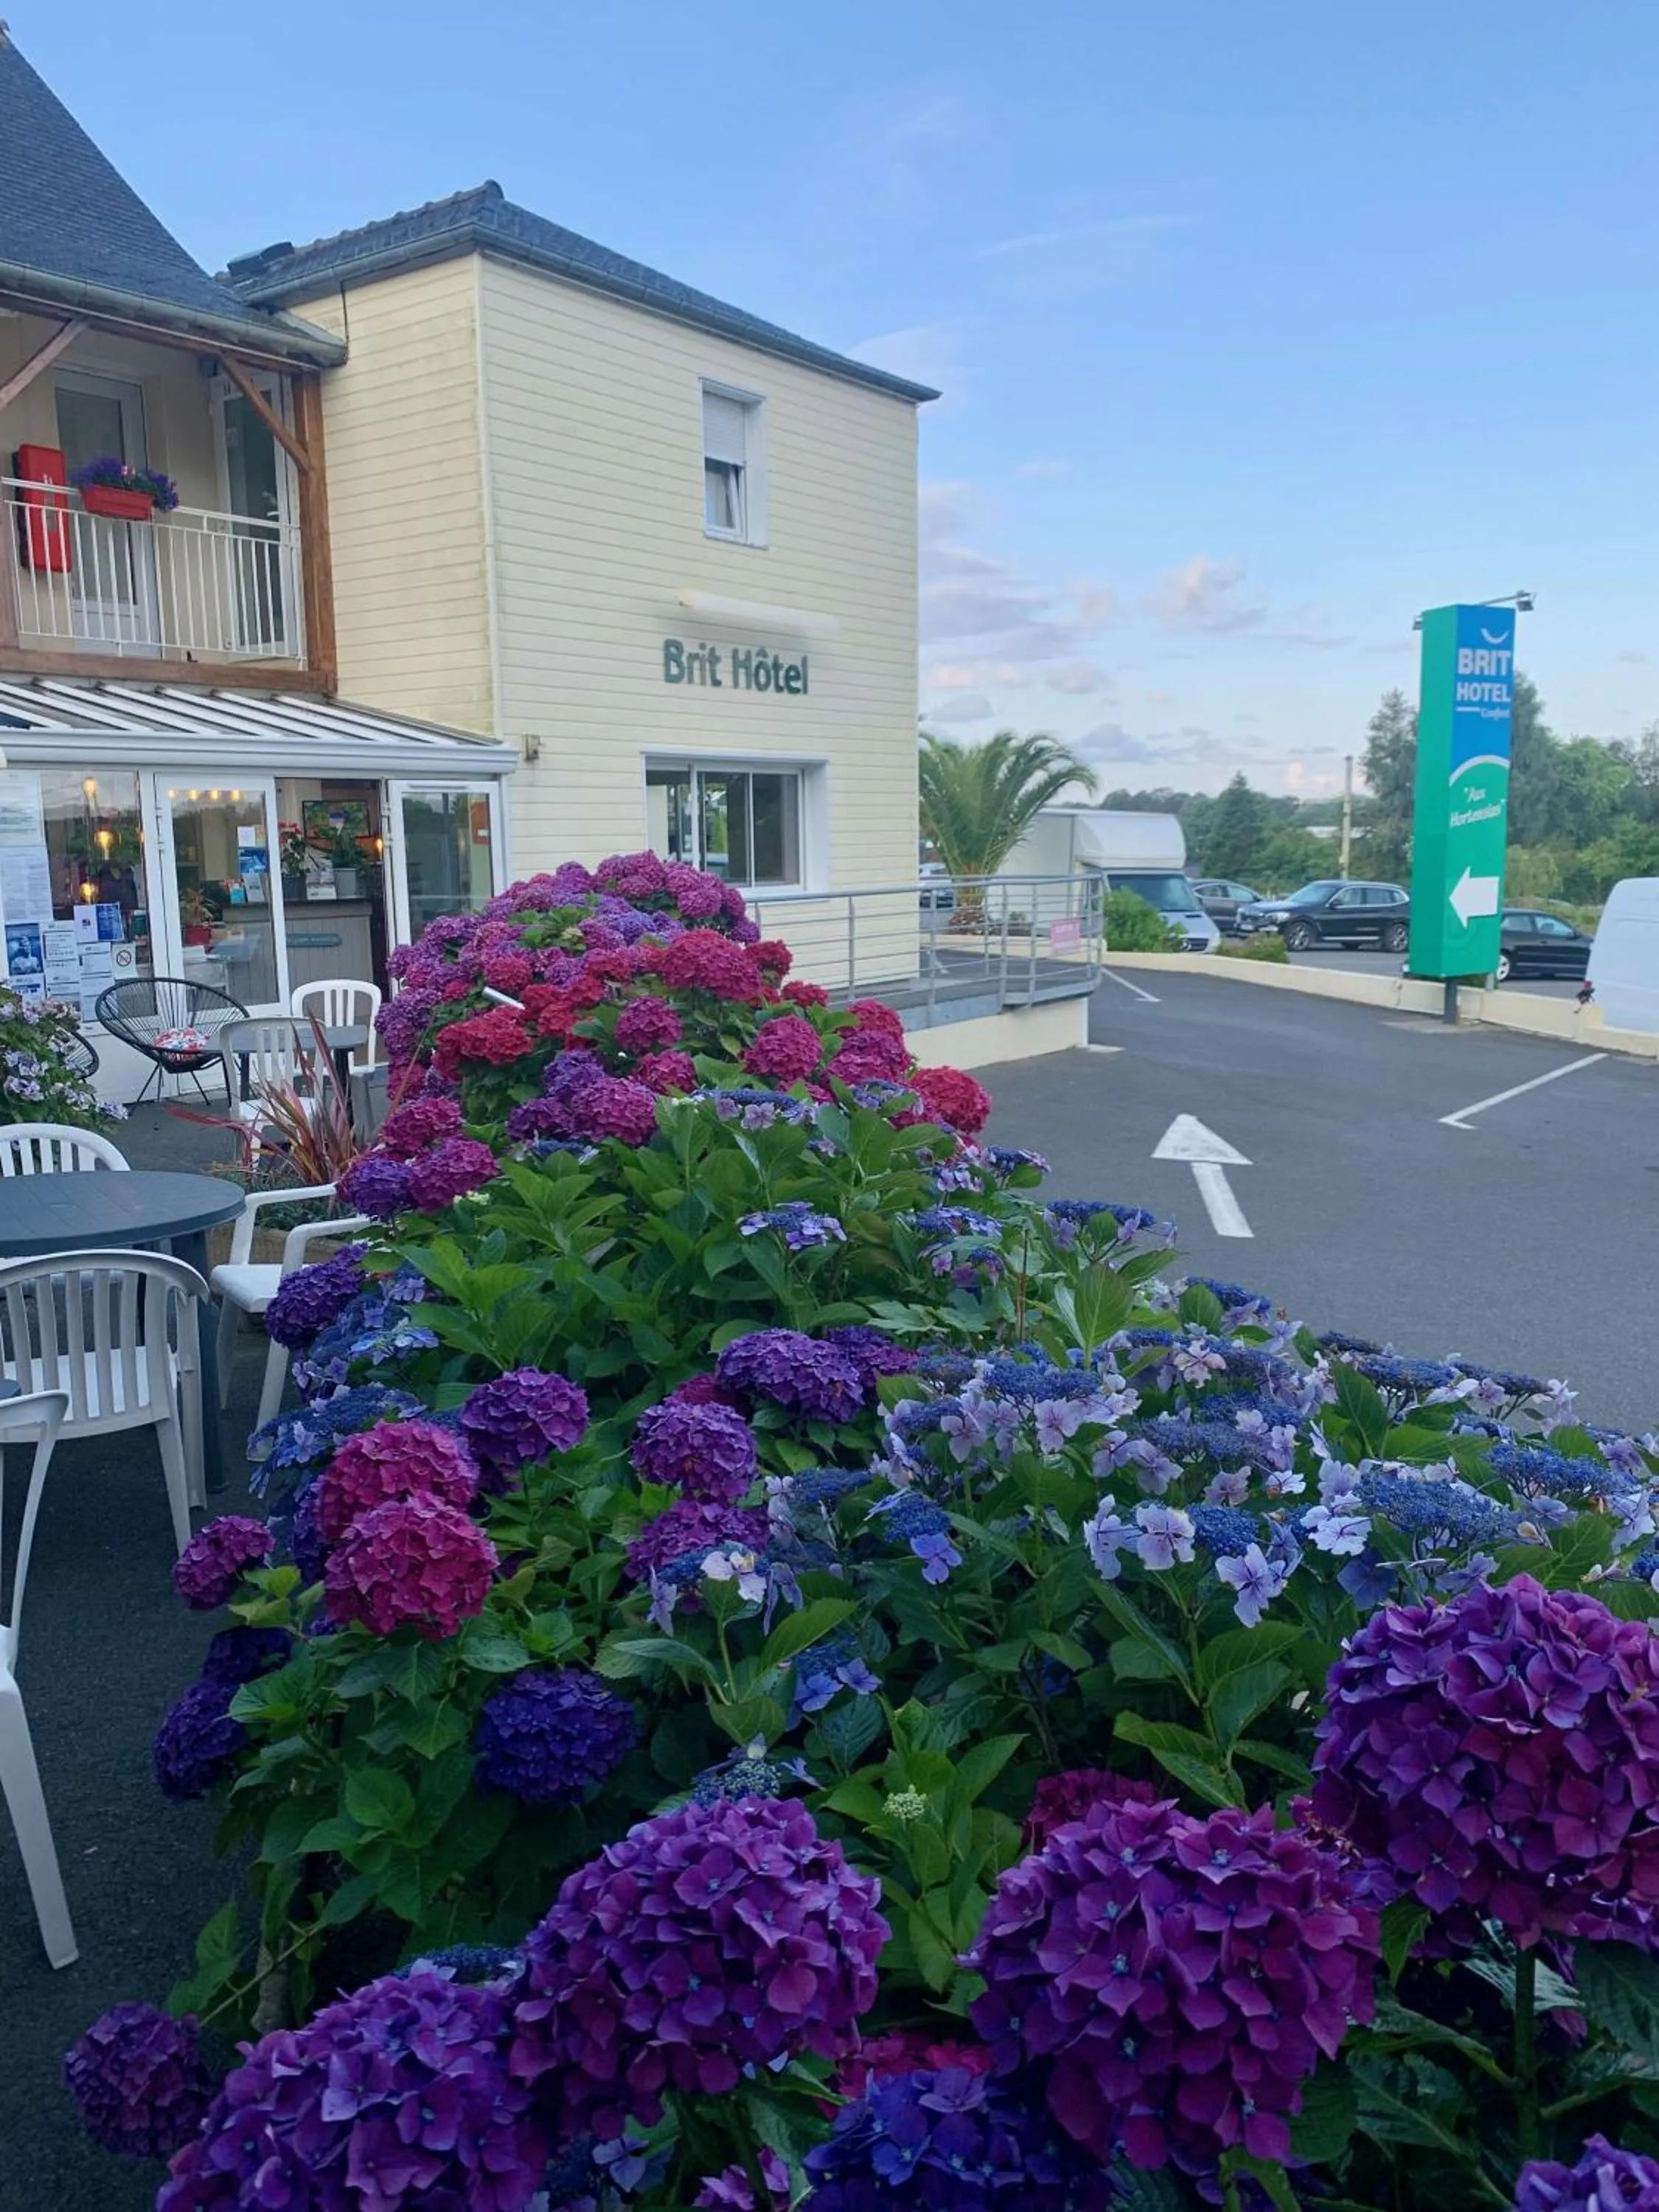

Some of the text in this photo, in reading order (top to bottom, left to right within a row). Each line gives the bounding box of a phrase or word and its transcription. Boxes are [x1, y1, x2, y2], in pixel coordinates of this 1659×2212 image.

[664, 639, 808, 694] Brit Hôtel
[1458, 648, 1511, 675] BRIT
[1456, 681, 1511, 703] HOTEL
